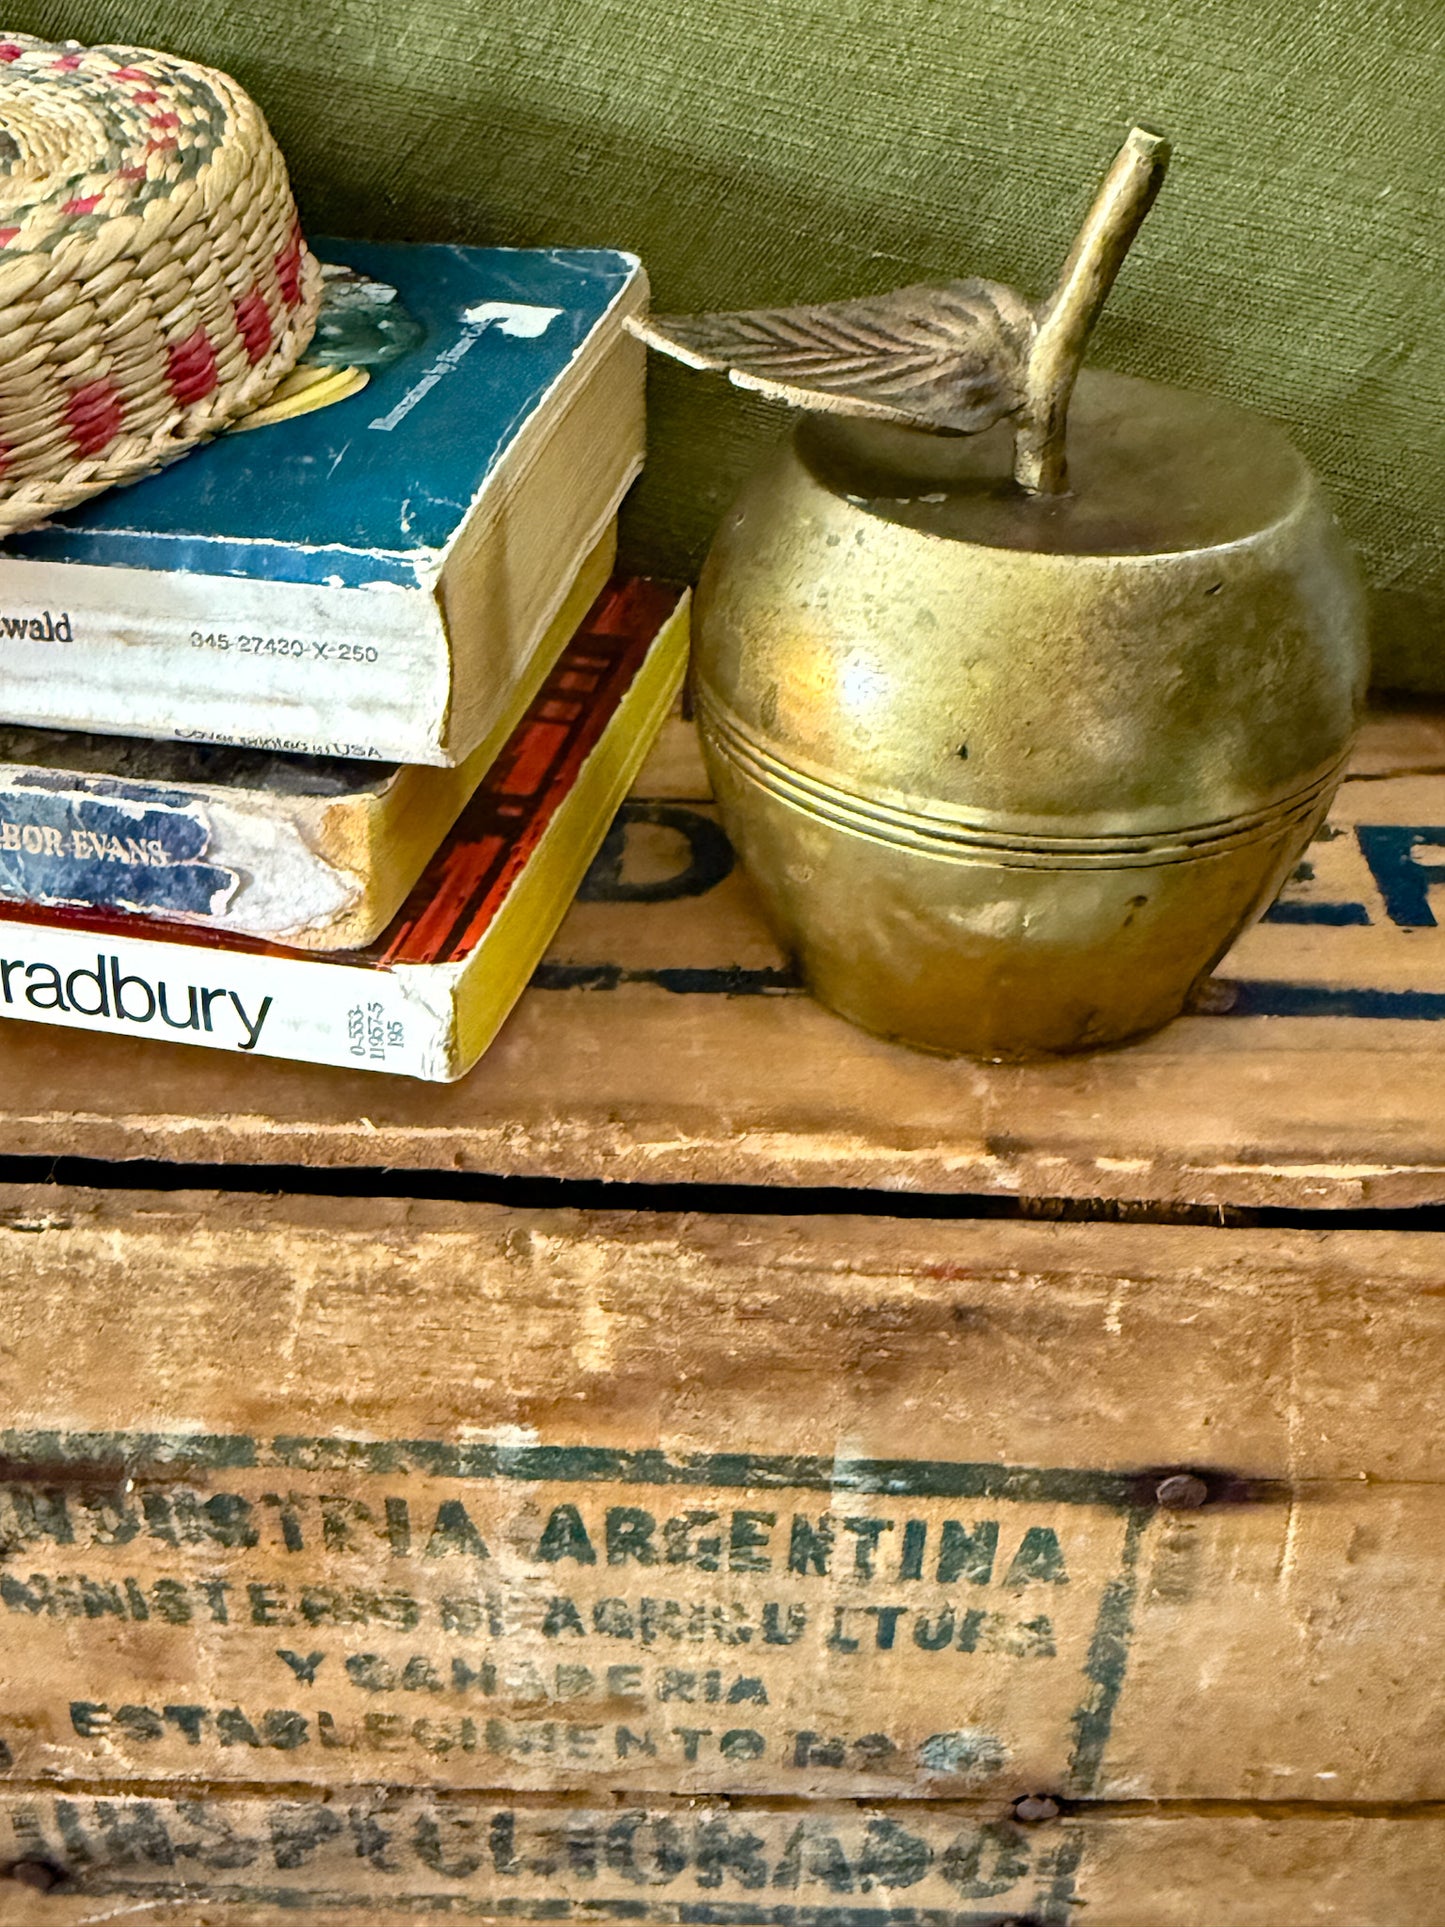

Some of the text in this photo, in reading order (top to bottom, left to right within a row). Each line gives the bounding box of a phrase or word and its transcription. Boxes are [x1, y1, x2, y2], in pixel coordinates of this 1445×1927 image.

[0, 610, 74, 642] wald
[0, 821, 172, 868] BOR EVANS
[0, 953, 274, 1050] radbury
[538, 1503, 1069, 1587] ARGENTINA
[276, 1649, 325, 1687] Y
